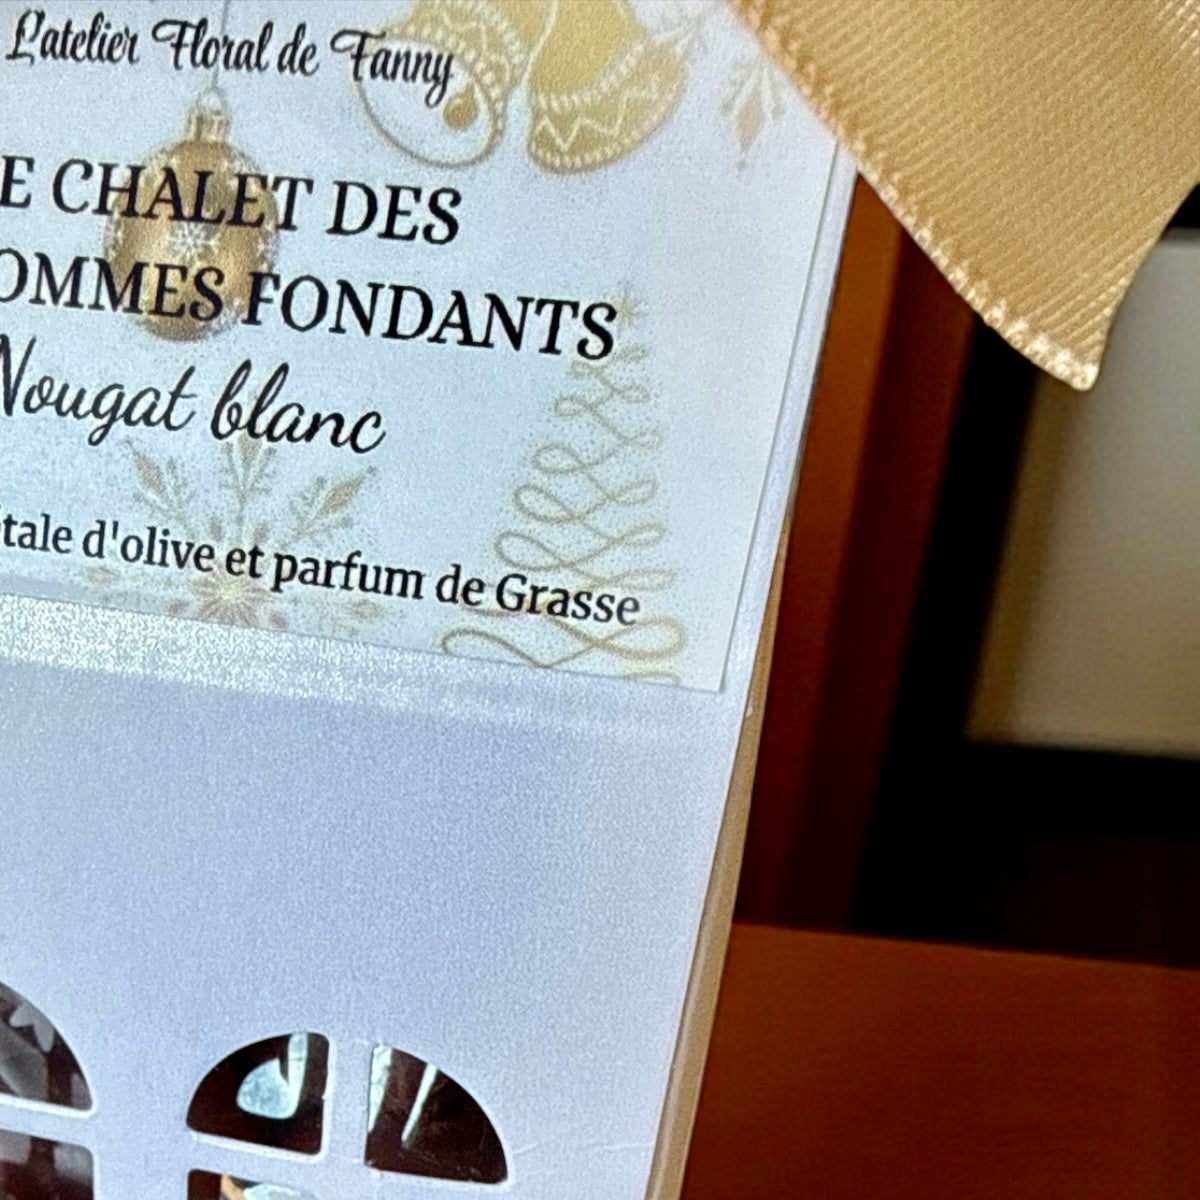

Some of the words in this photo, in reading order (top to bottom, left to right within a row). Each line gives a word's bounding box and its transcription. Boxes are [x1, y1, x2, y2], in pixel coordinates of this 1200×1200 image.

[151, 17, 272, 72] Floral
[277, 22, 317, 76] de
[329, 29, 455, 107] Fanny
[52, 158, 314, 234] CHALET
[325, 180, 462, 246] DES
[239, 269, 618, 361] FONDANTS
[211, 361, 386, 454] blanc
[82, 519, 215, 573] d'olive
[225, 544, 265, 579] et
[270, 550, 426, 600] parfum
[435, 563, 486, 606] de
[495, 573, 640, 626] Grasse
